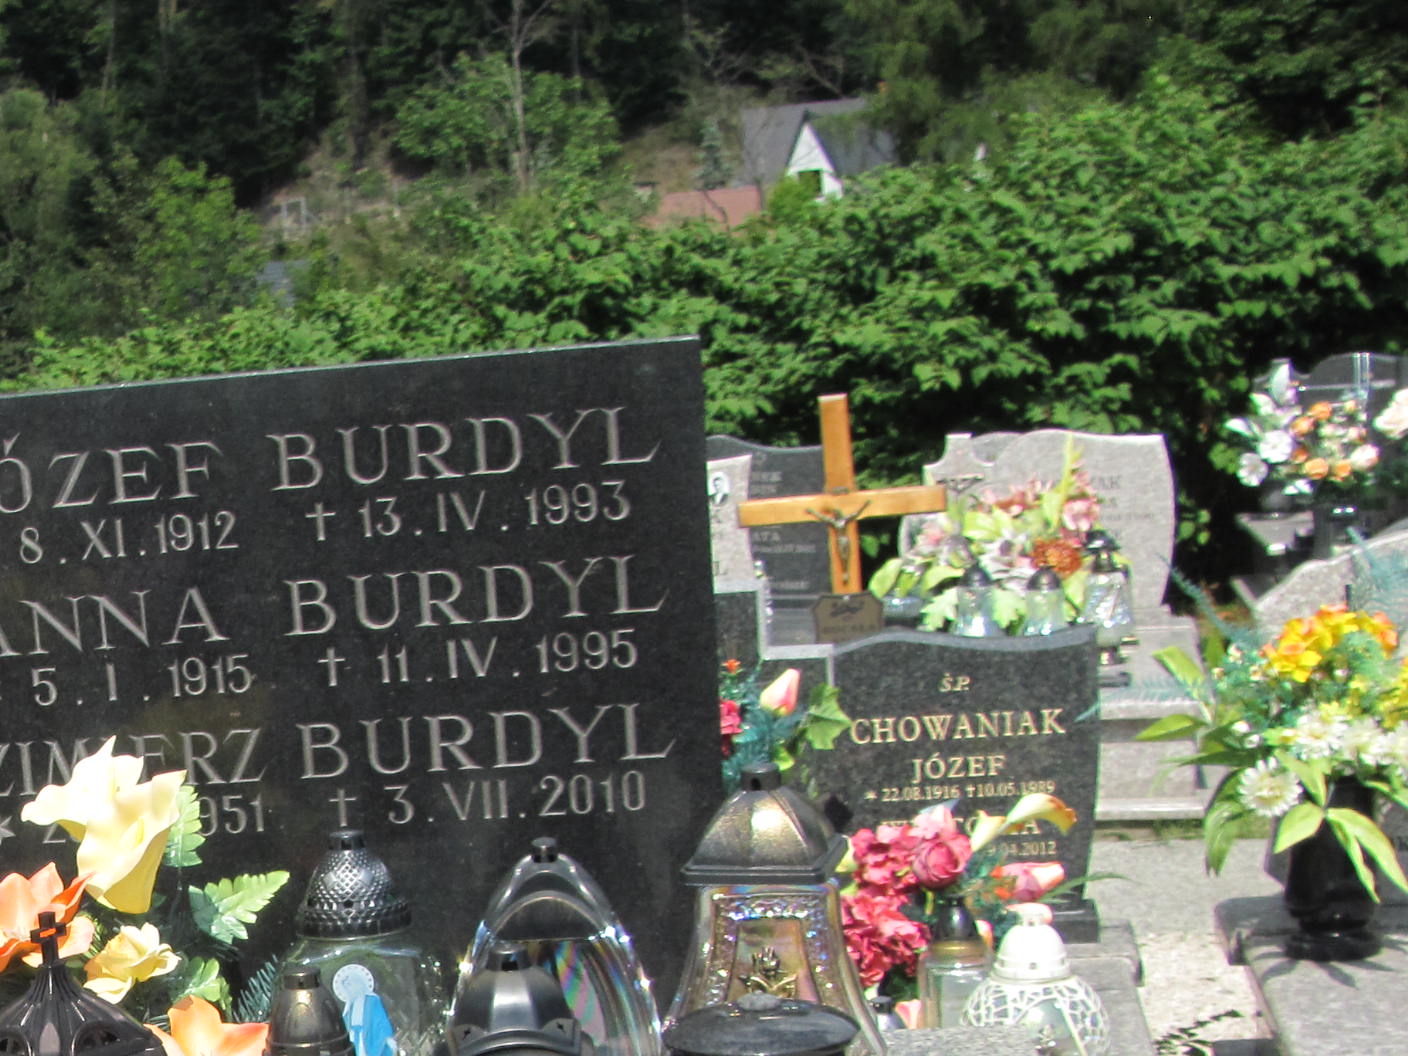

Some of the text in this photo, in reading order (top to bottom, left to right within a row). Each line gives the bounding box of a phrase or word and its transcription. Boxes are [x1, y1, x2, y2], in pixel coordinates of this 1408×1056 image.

[266, 407, 661, 492] BURDYL
[283, 554, 670, 637] BURDYL
[296, 703, 677, 780] BURDYL
[850, 707, 1067, 745] CHOWANIAK
[912, 752, 1007, 784] JÓZEF
